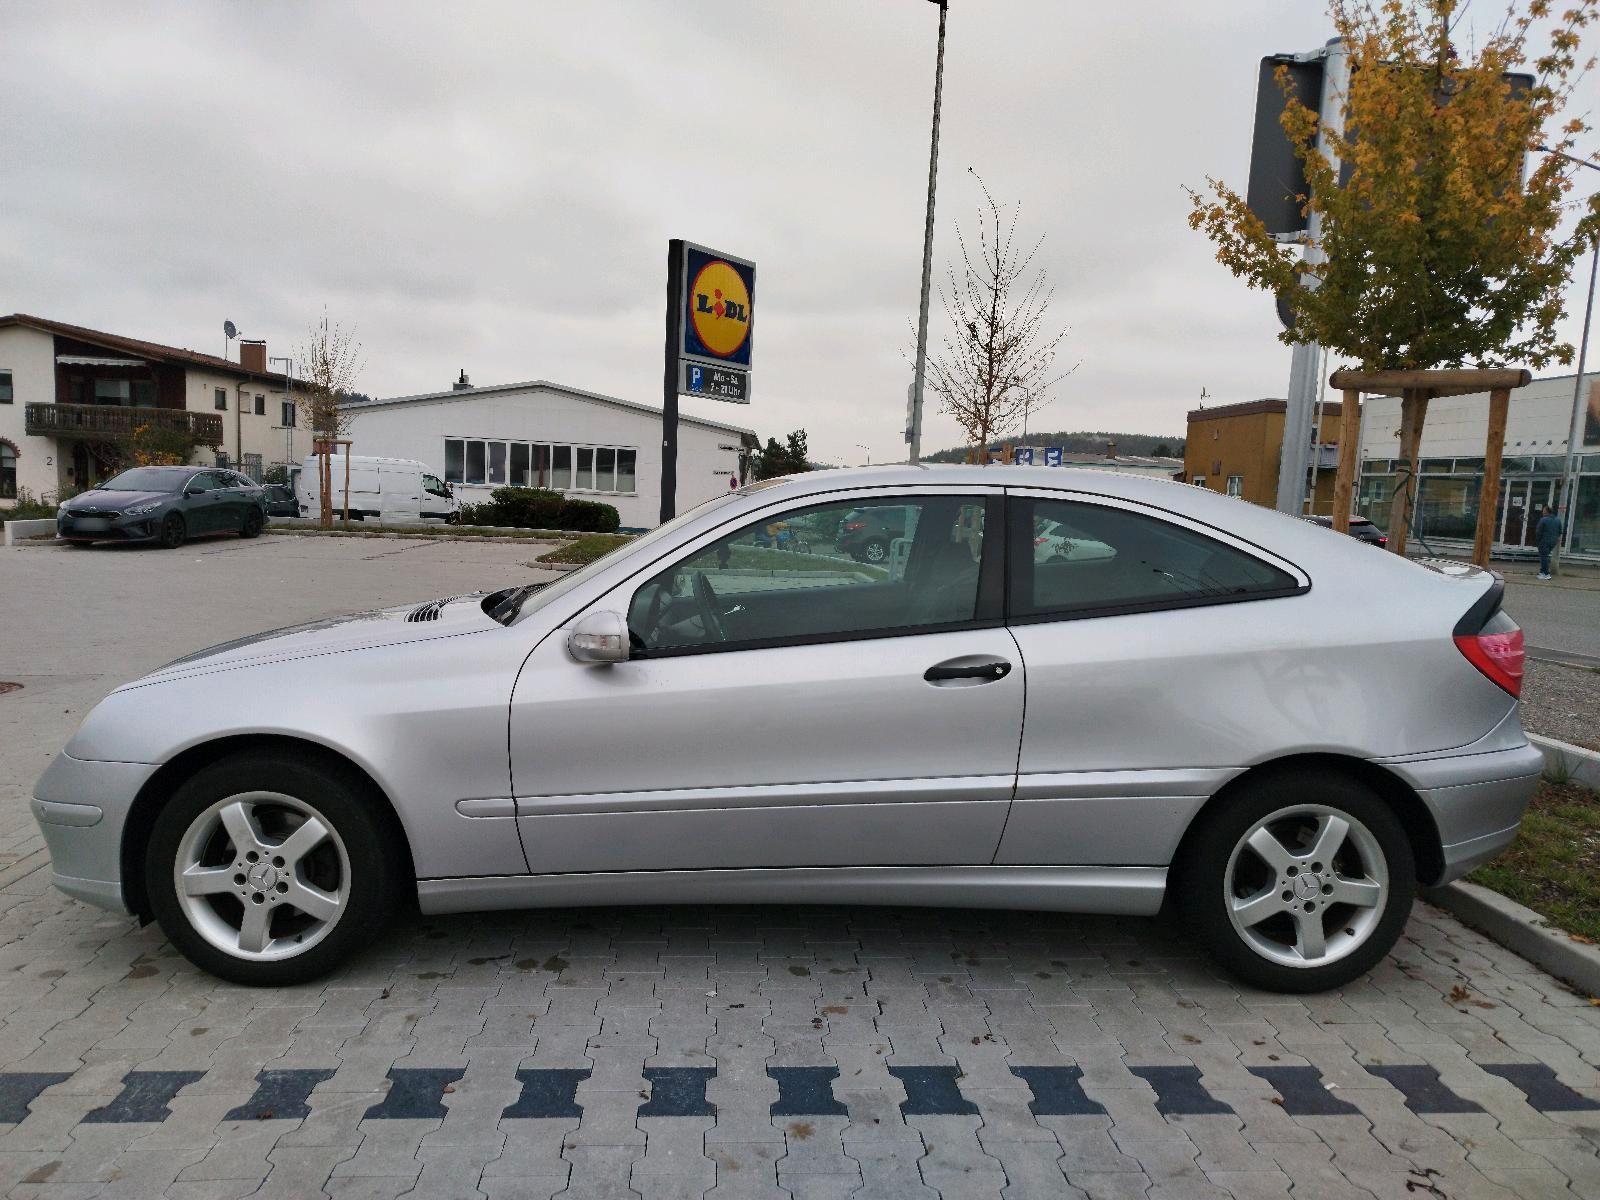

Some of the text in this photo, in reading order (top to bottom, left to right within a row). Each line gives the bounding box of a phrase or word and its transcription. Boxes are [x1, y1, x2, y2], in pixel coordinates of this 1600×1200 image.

[693, 368, 701, 384] P
[714, 372, 725, 382] Mo
[731, 375, 739, 385] Sa
[711, 383, 715, 392] 7
[729, 386, 741, 396] Uhr
[46, 456, 53, 466] 2
